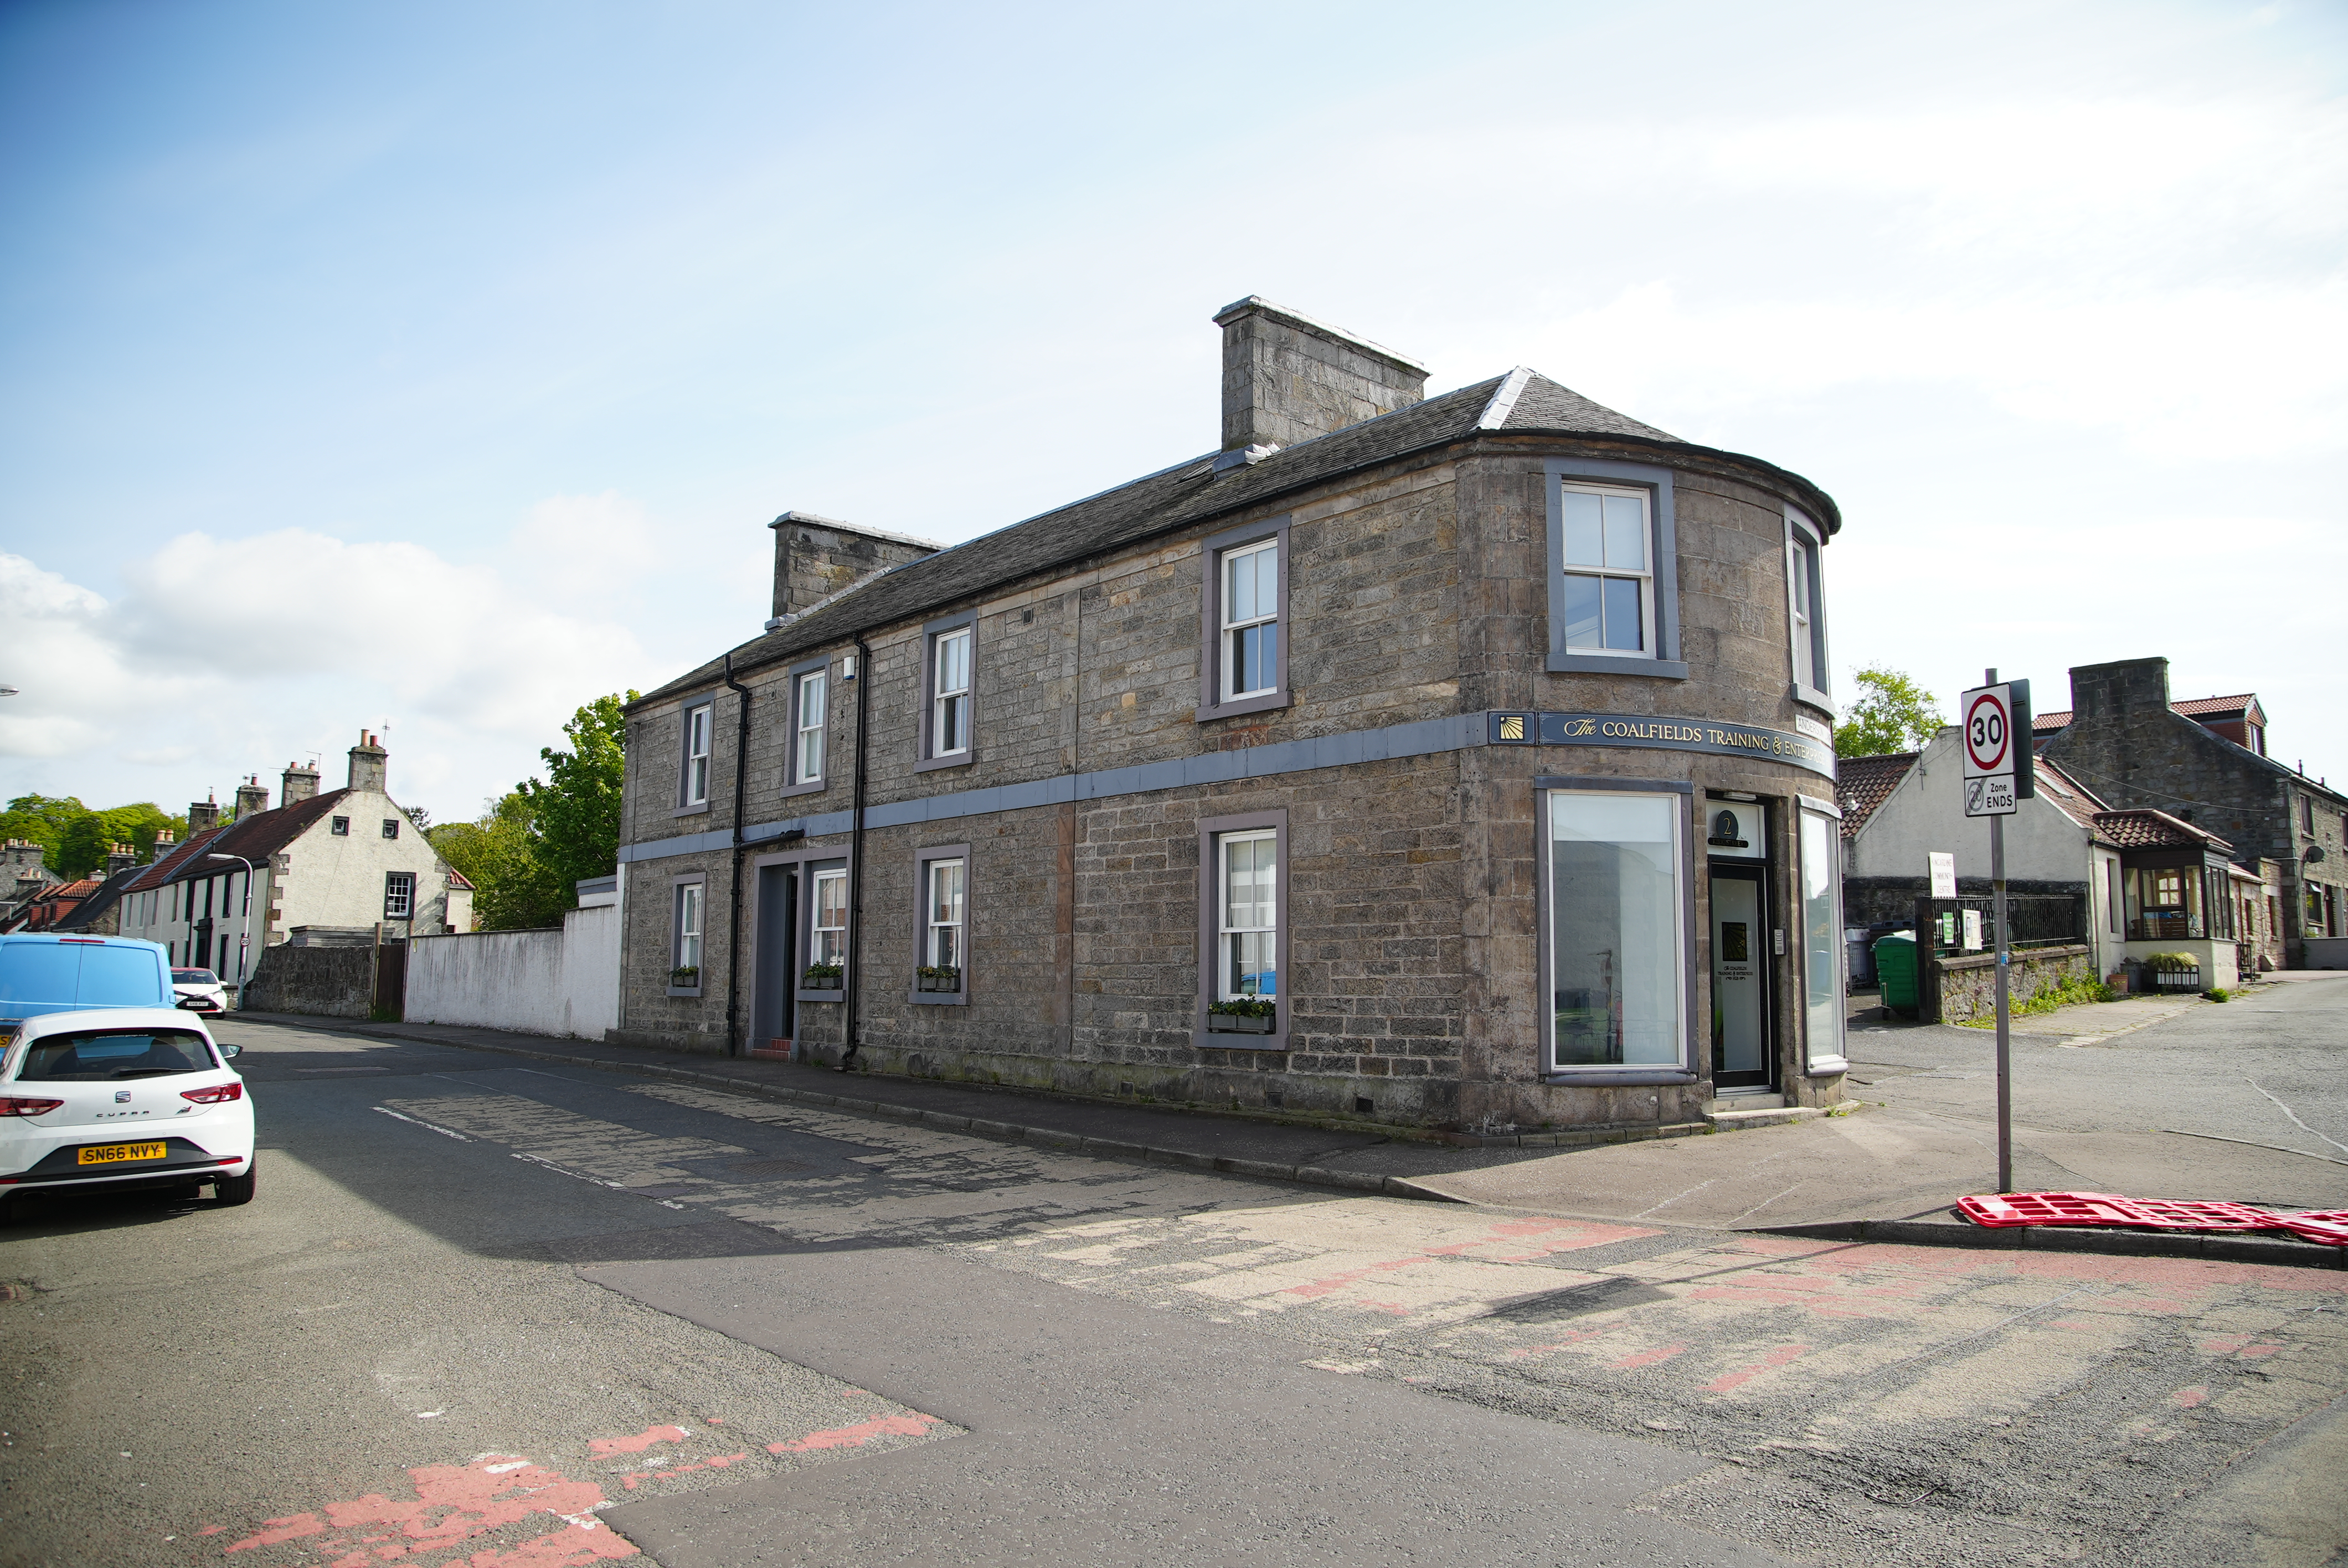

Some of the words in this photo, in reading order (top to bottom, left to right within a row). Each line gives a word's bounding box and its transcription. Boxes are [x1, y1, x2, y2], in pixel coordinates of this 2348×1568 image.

[1798, 718, 1824, 737] ANDERSON
[1972, 714, 2002, 747] 30
[1564, 718, 1597, 737] The
[1602, 721, 1702, 742] COALFIELDS
[1707, 729, 1769, 751] TRAINING
[1772, 736, 1782, 755] &
[1784, 740, 1825, 765] ENTERPRISE
[1990, 783, 2007, 793] Zone
[1987, 794, 2012, 808] ENDS
[1723, 817, 1732, 834] 2
[85, 1146, 126, 1162] SN66
[130, 1144, 159, 1159] NVY
